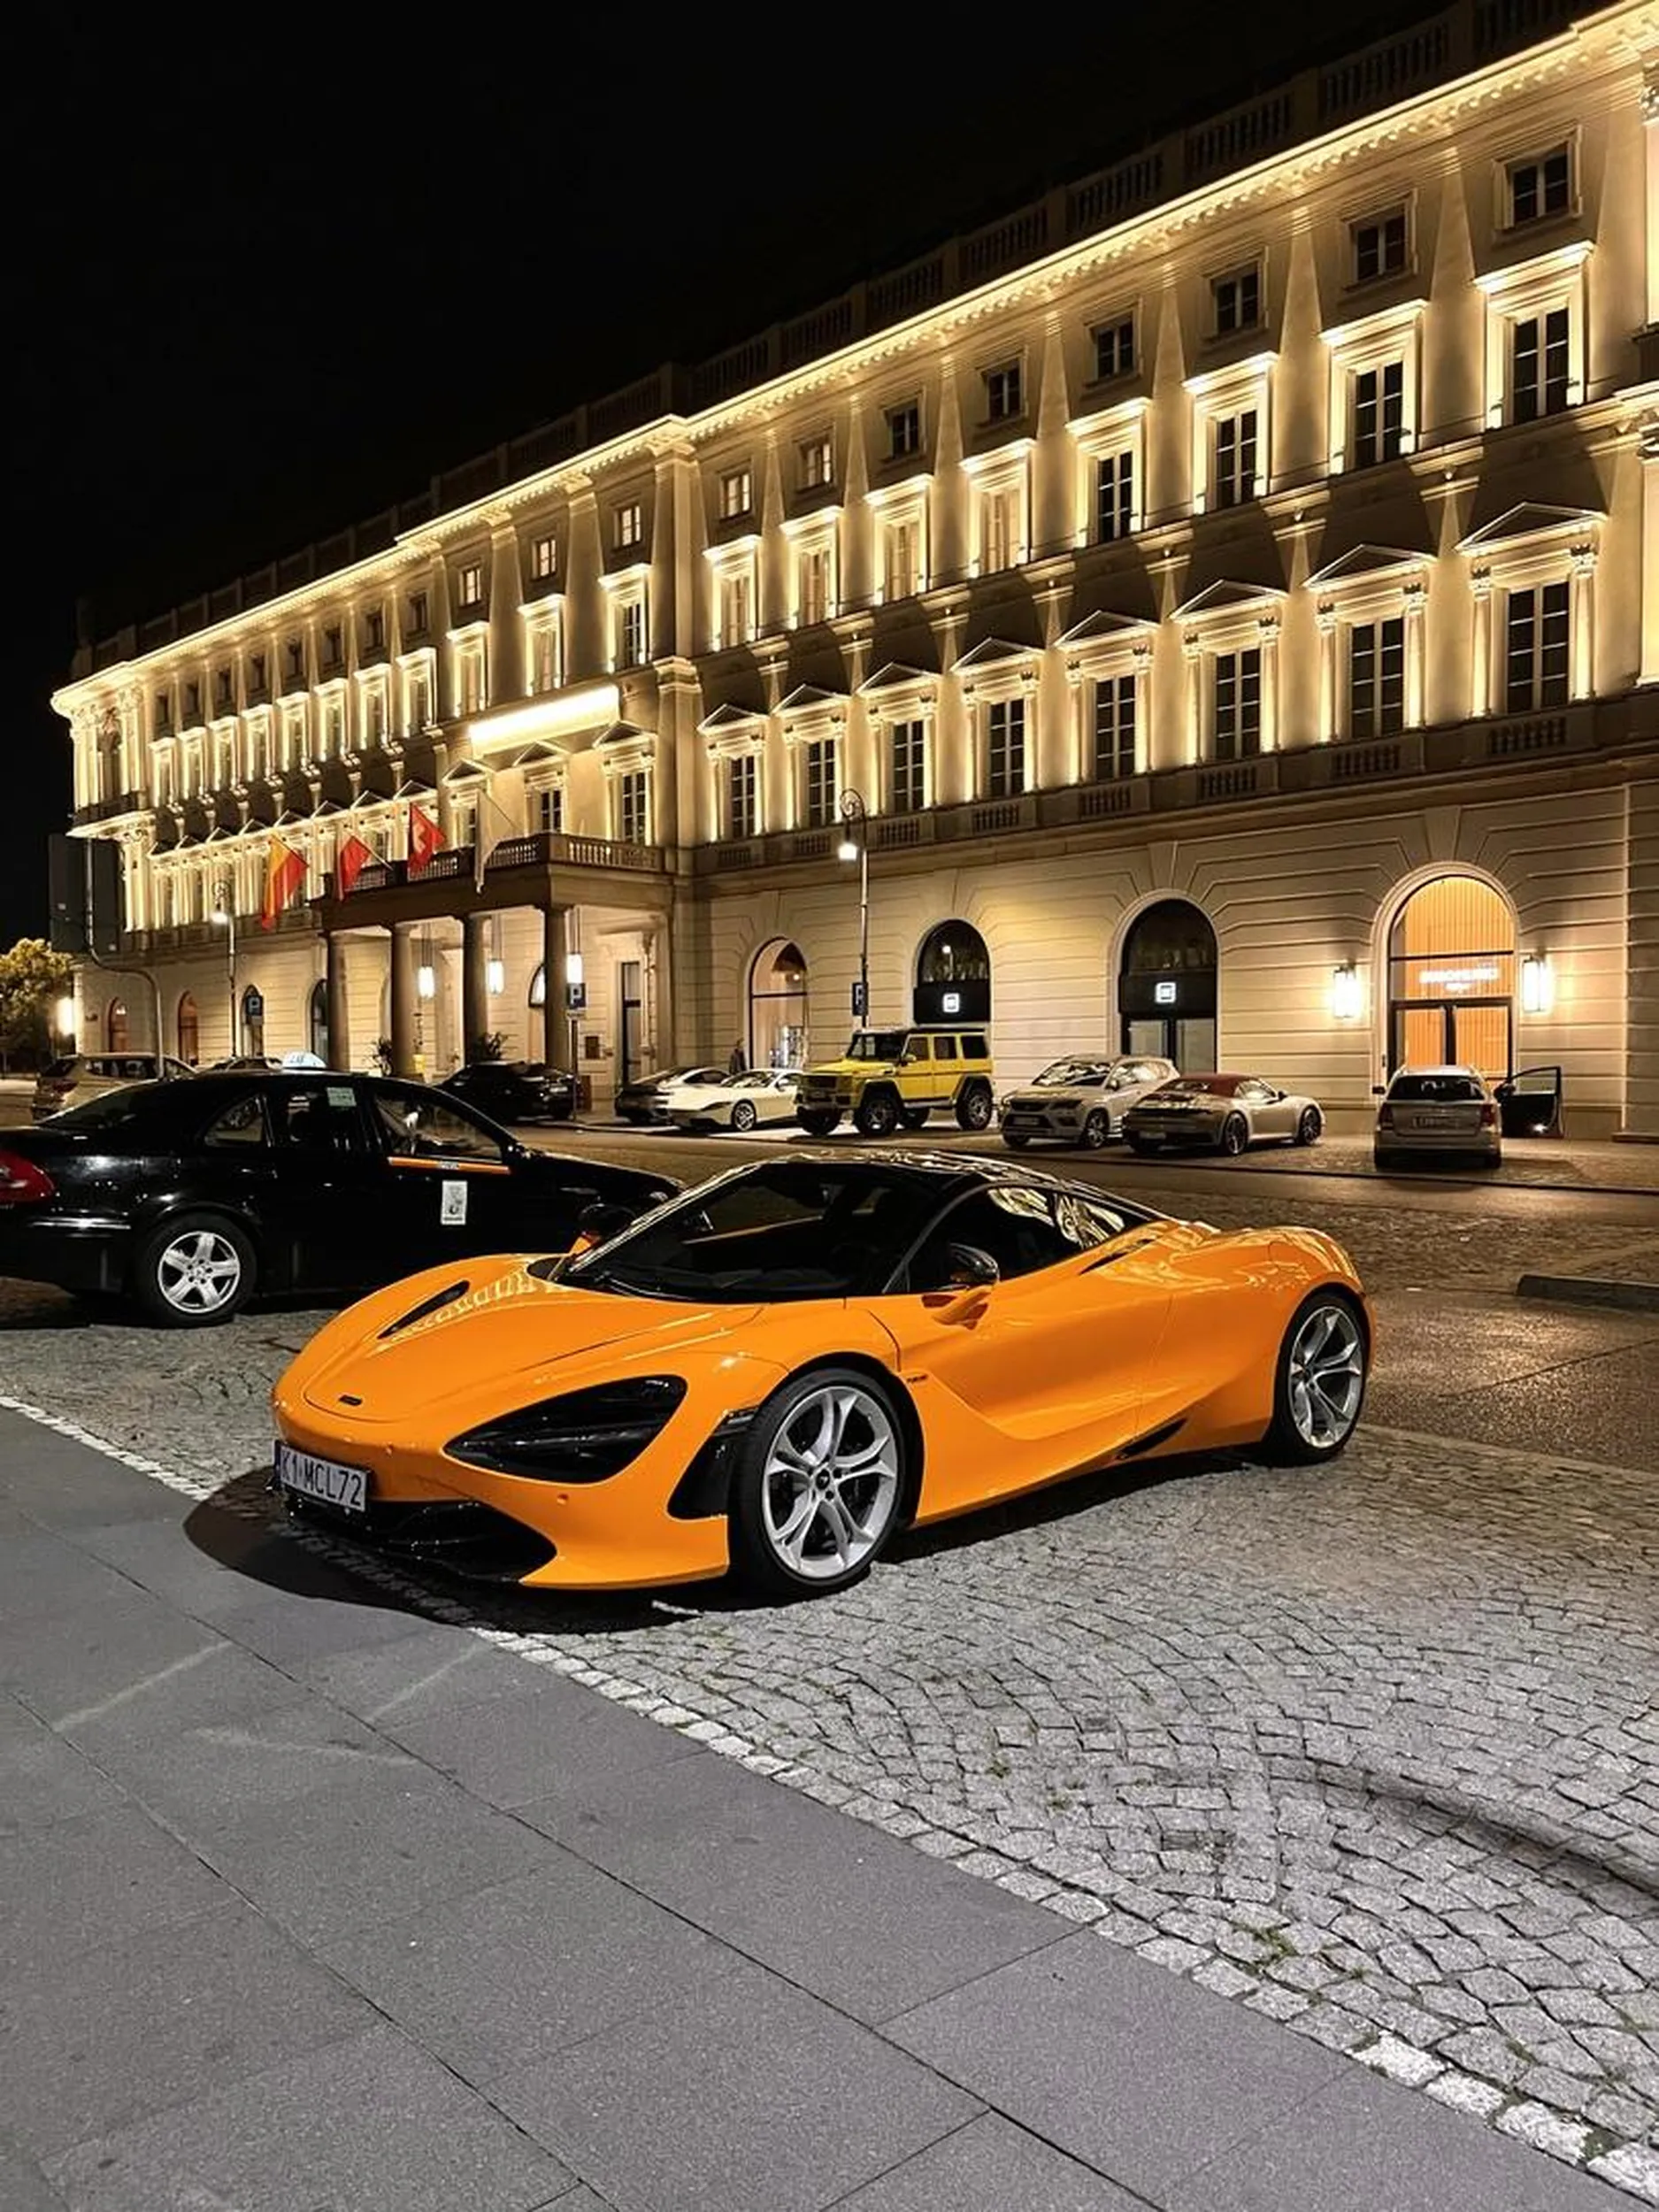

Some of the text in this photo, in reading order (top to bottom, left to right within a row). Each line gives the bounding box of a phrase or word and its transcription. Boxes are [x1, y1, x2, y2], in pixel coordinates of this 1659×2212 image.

[570, 985, 582, 1005] P
[249, 997, 260, 1014] P
[280, 1449, 362, 1507] K1 MCL72
